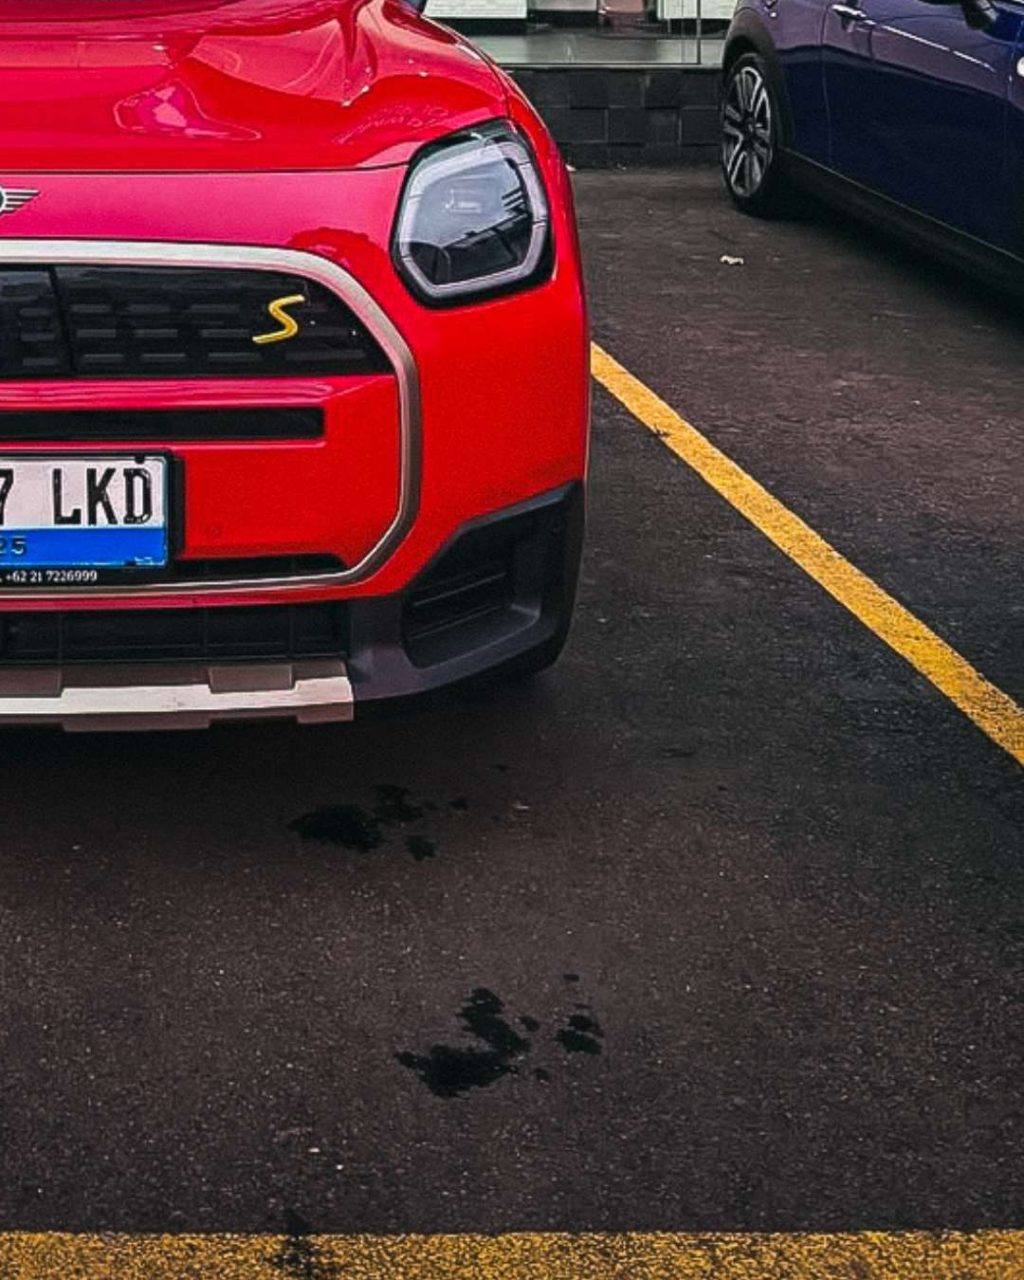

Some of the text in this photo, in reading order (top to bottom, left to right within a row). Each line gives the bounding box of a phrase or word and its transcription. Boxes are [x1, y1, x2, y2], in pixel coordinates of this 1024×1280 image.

[52, 468, 153, 527] LKD
[5, 570, 27, 582] +62
[30, 570, 43, 582] 21
